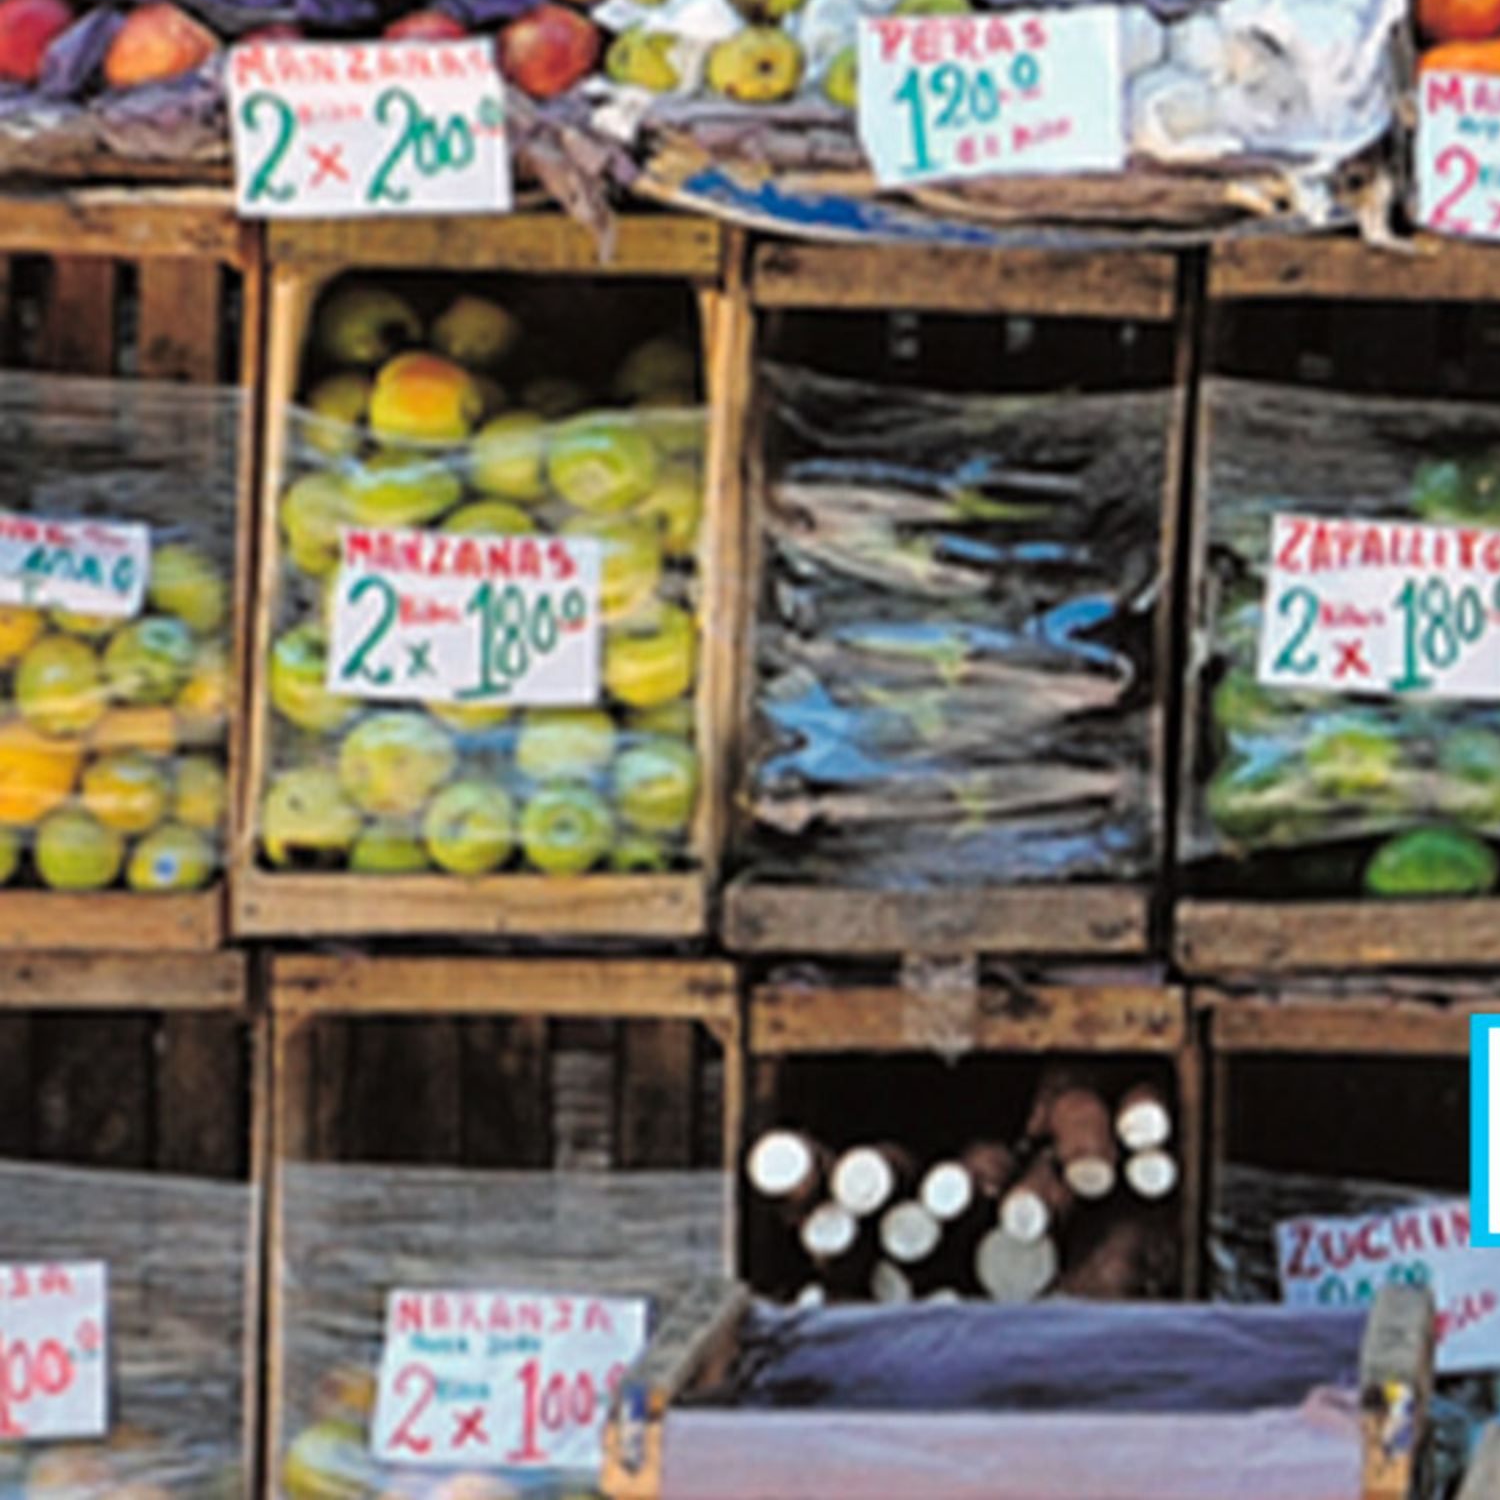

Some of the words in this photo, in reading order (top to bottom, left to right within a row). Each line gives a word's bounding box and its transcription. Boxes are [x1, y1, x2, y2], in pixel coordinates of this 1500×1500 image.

[240, 88, 299, 204] 2
[1429, 144, 1480, 235] 2
[345, 528, 580, 583] MANZANAS
[340, 572, 398, 686] 2
[1271, 584, 1320, 676] 2
[387, 1361, 438, 1455] 2
